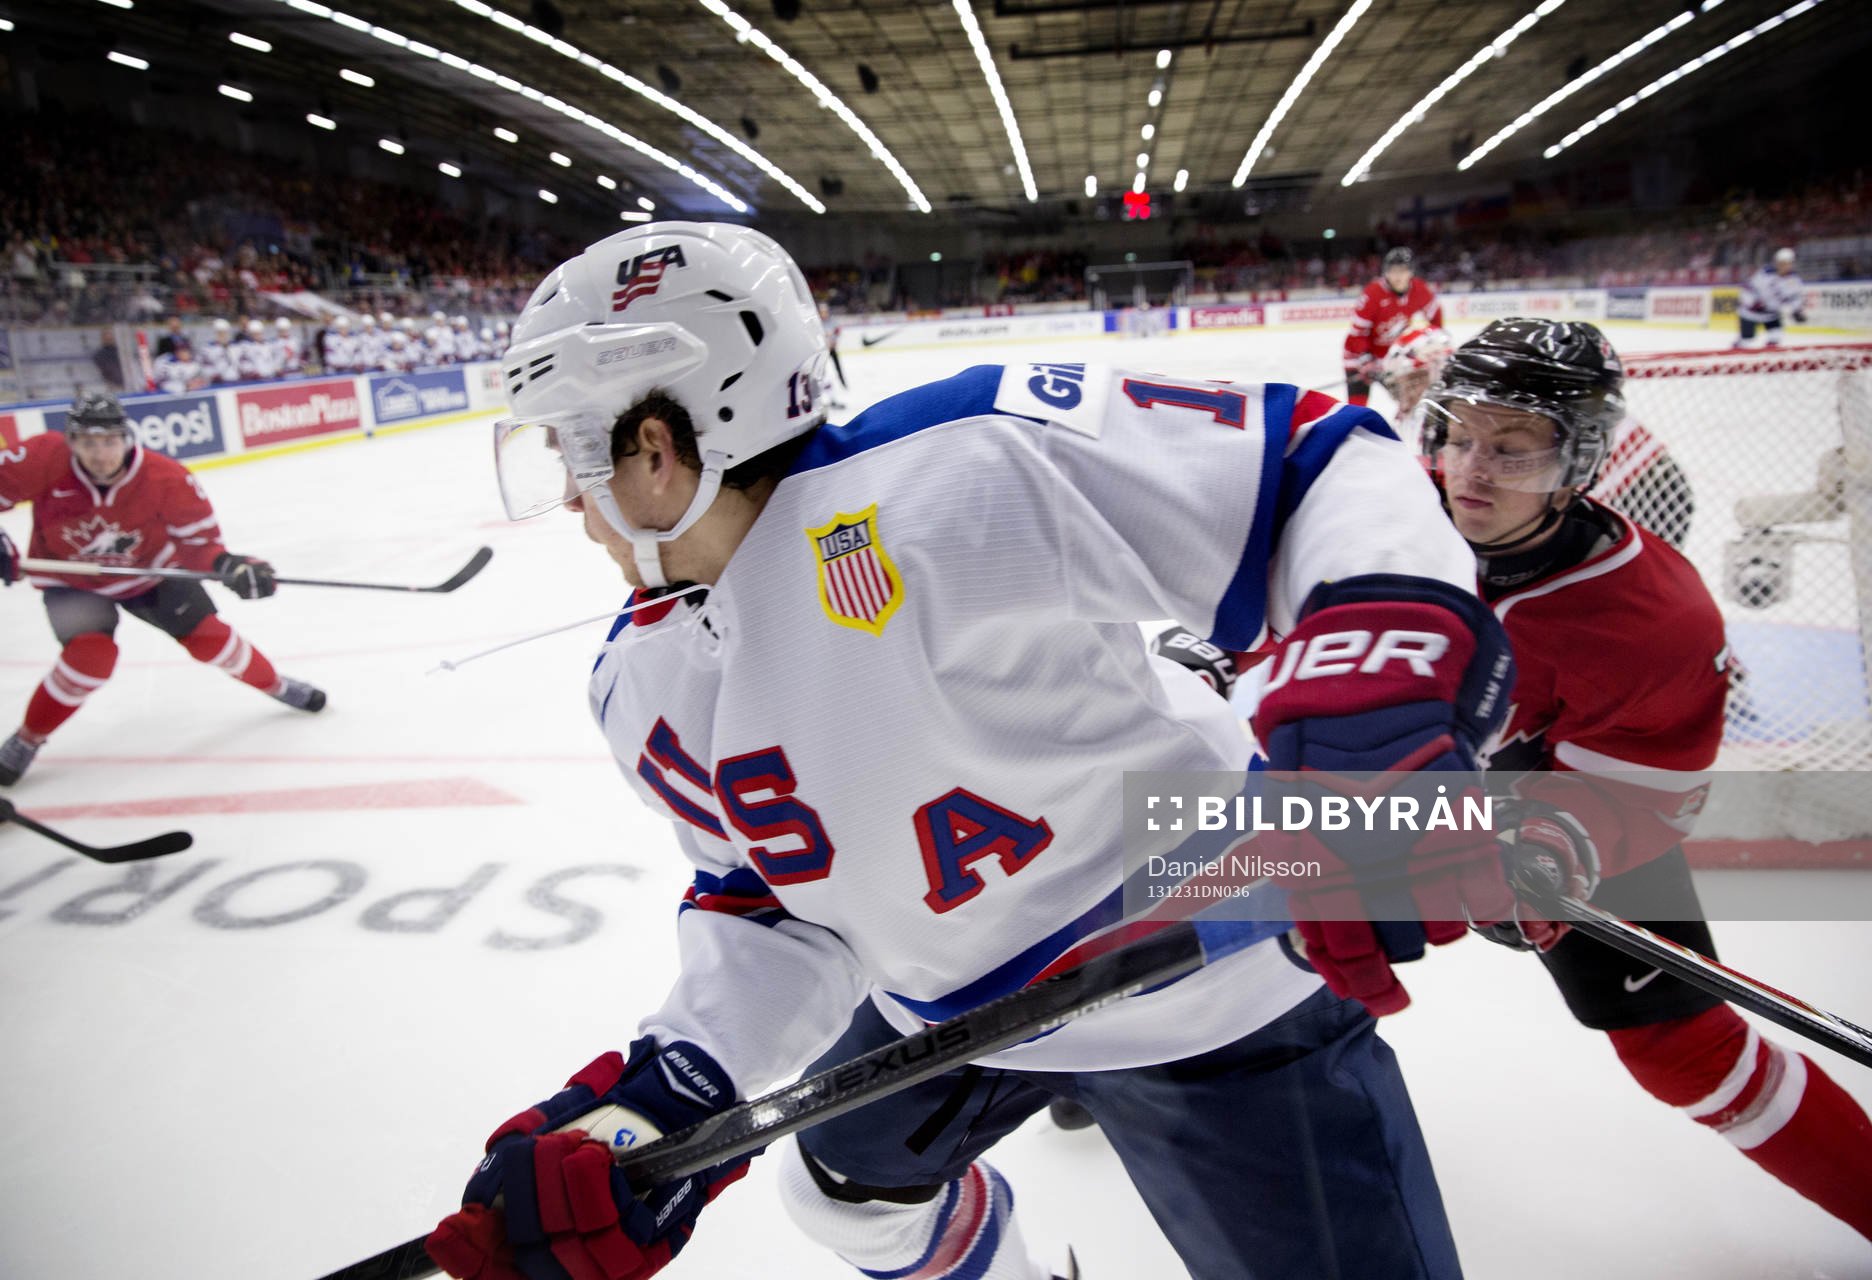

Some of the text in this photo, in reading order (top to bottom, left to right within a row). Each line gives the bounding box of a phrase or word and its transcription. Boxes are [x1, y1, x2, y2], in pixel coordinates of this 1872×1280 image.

[612, 244, 687, 312] USA
[1122, 373, 1247, 431] 1
[823, 526, 867, 557] USA
[637, 716, 1055, 914] USA
[665, 1049, 720, 1099] BAUER
[613, 1128, 637, 1148] 13
[655, 1178, 692, 1229] BAUER
